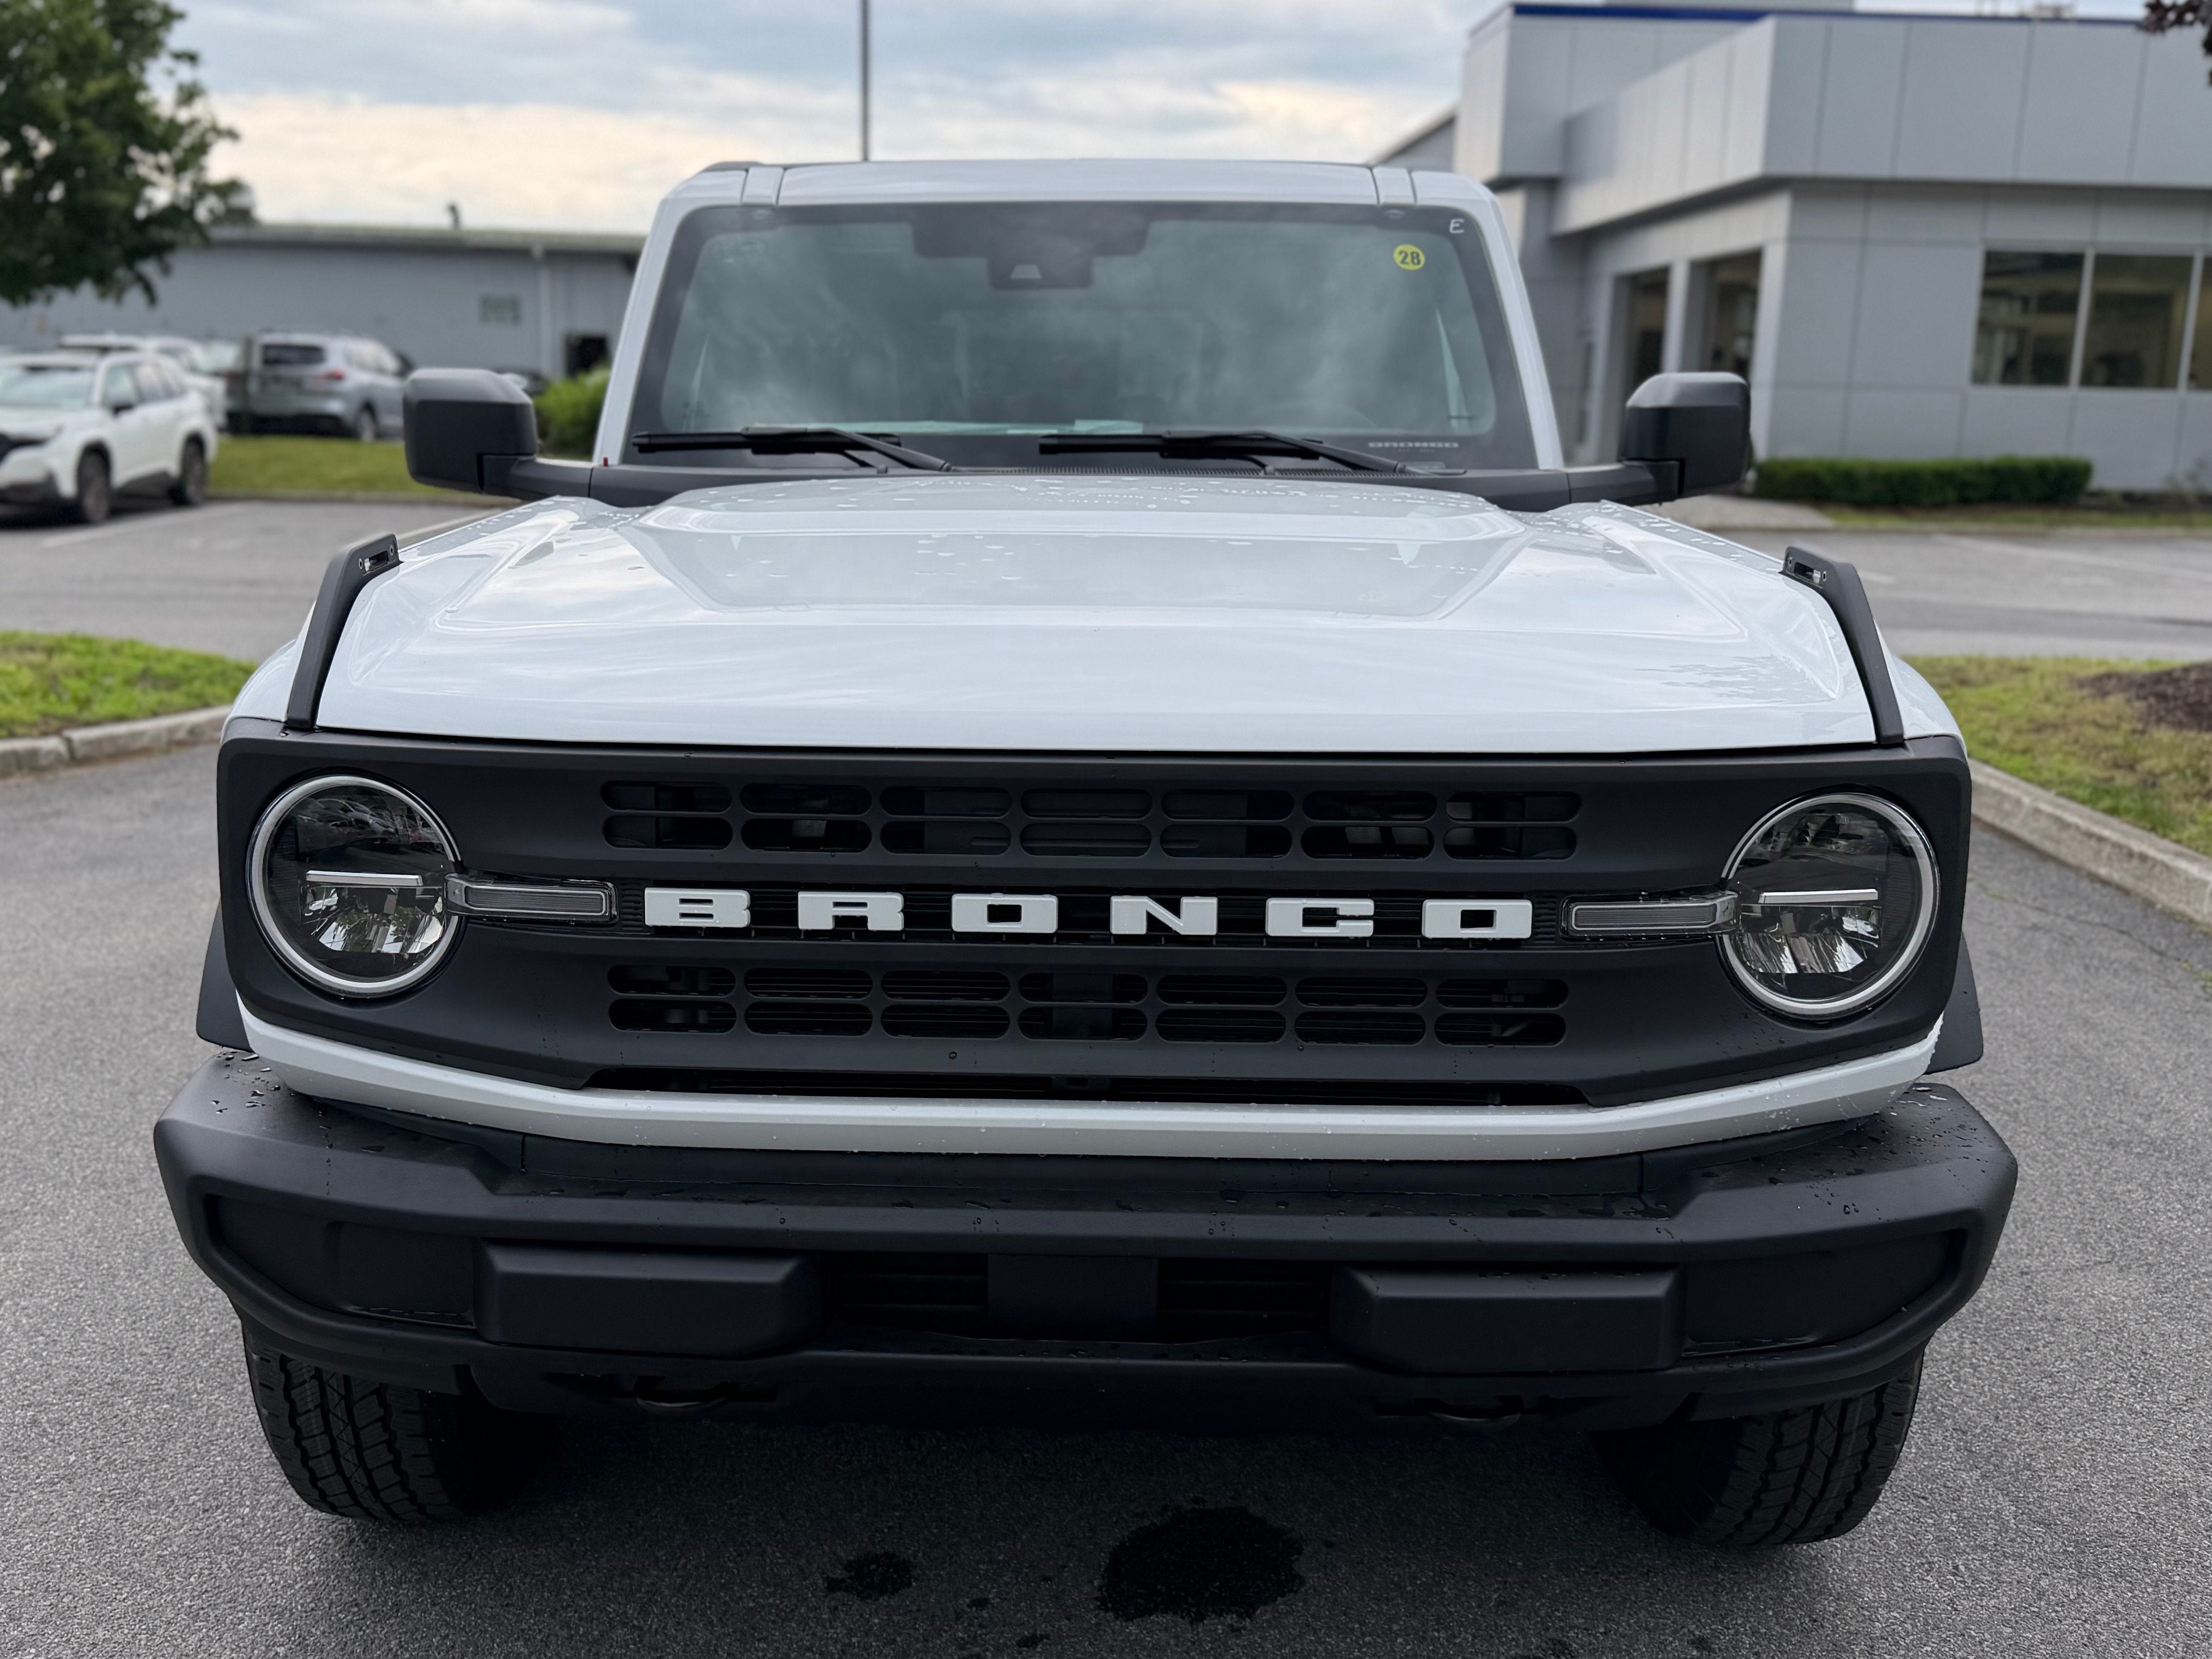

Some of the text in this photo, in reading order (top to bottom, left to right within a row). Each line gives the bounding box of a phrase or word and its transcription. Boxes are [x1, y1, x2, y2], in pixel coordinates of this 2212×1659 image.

[1449, 219, 1464, 233] E
[1398, 250, 1421, 266] 28
[644, 887, 1533, 939] BRONCO
